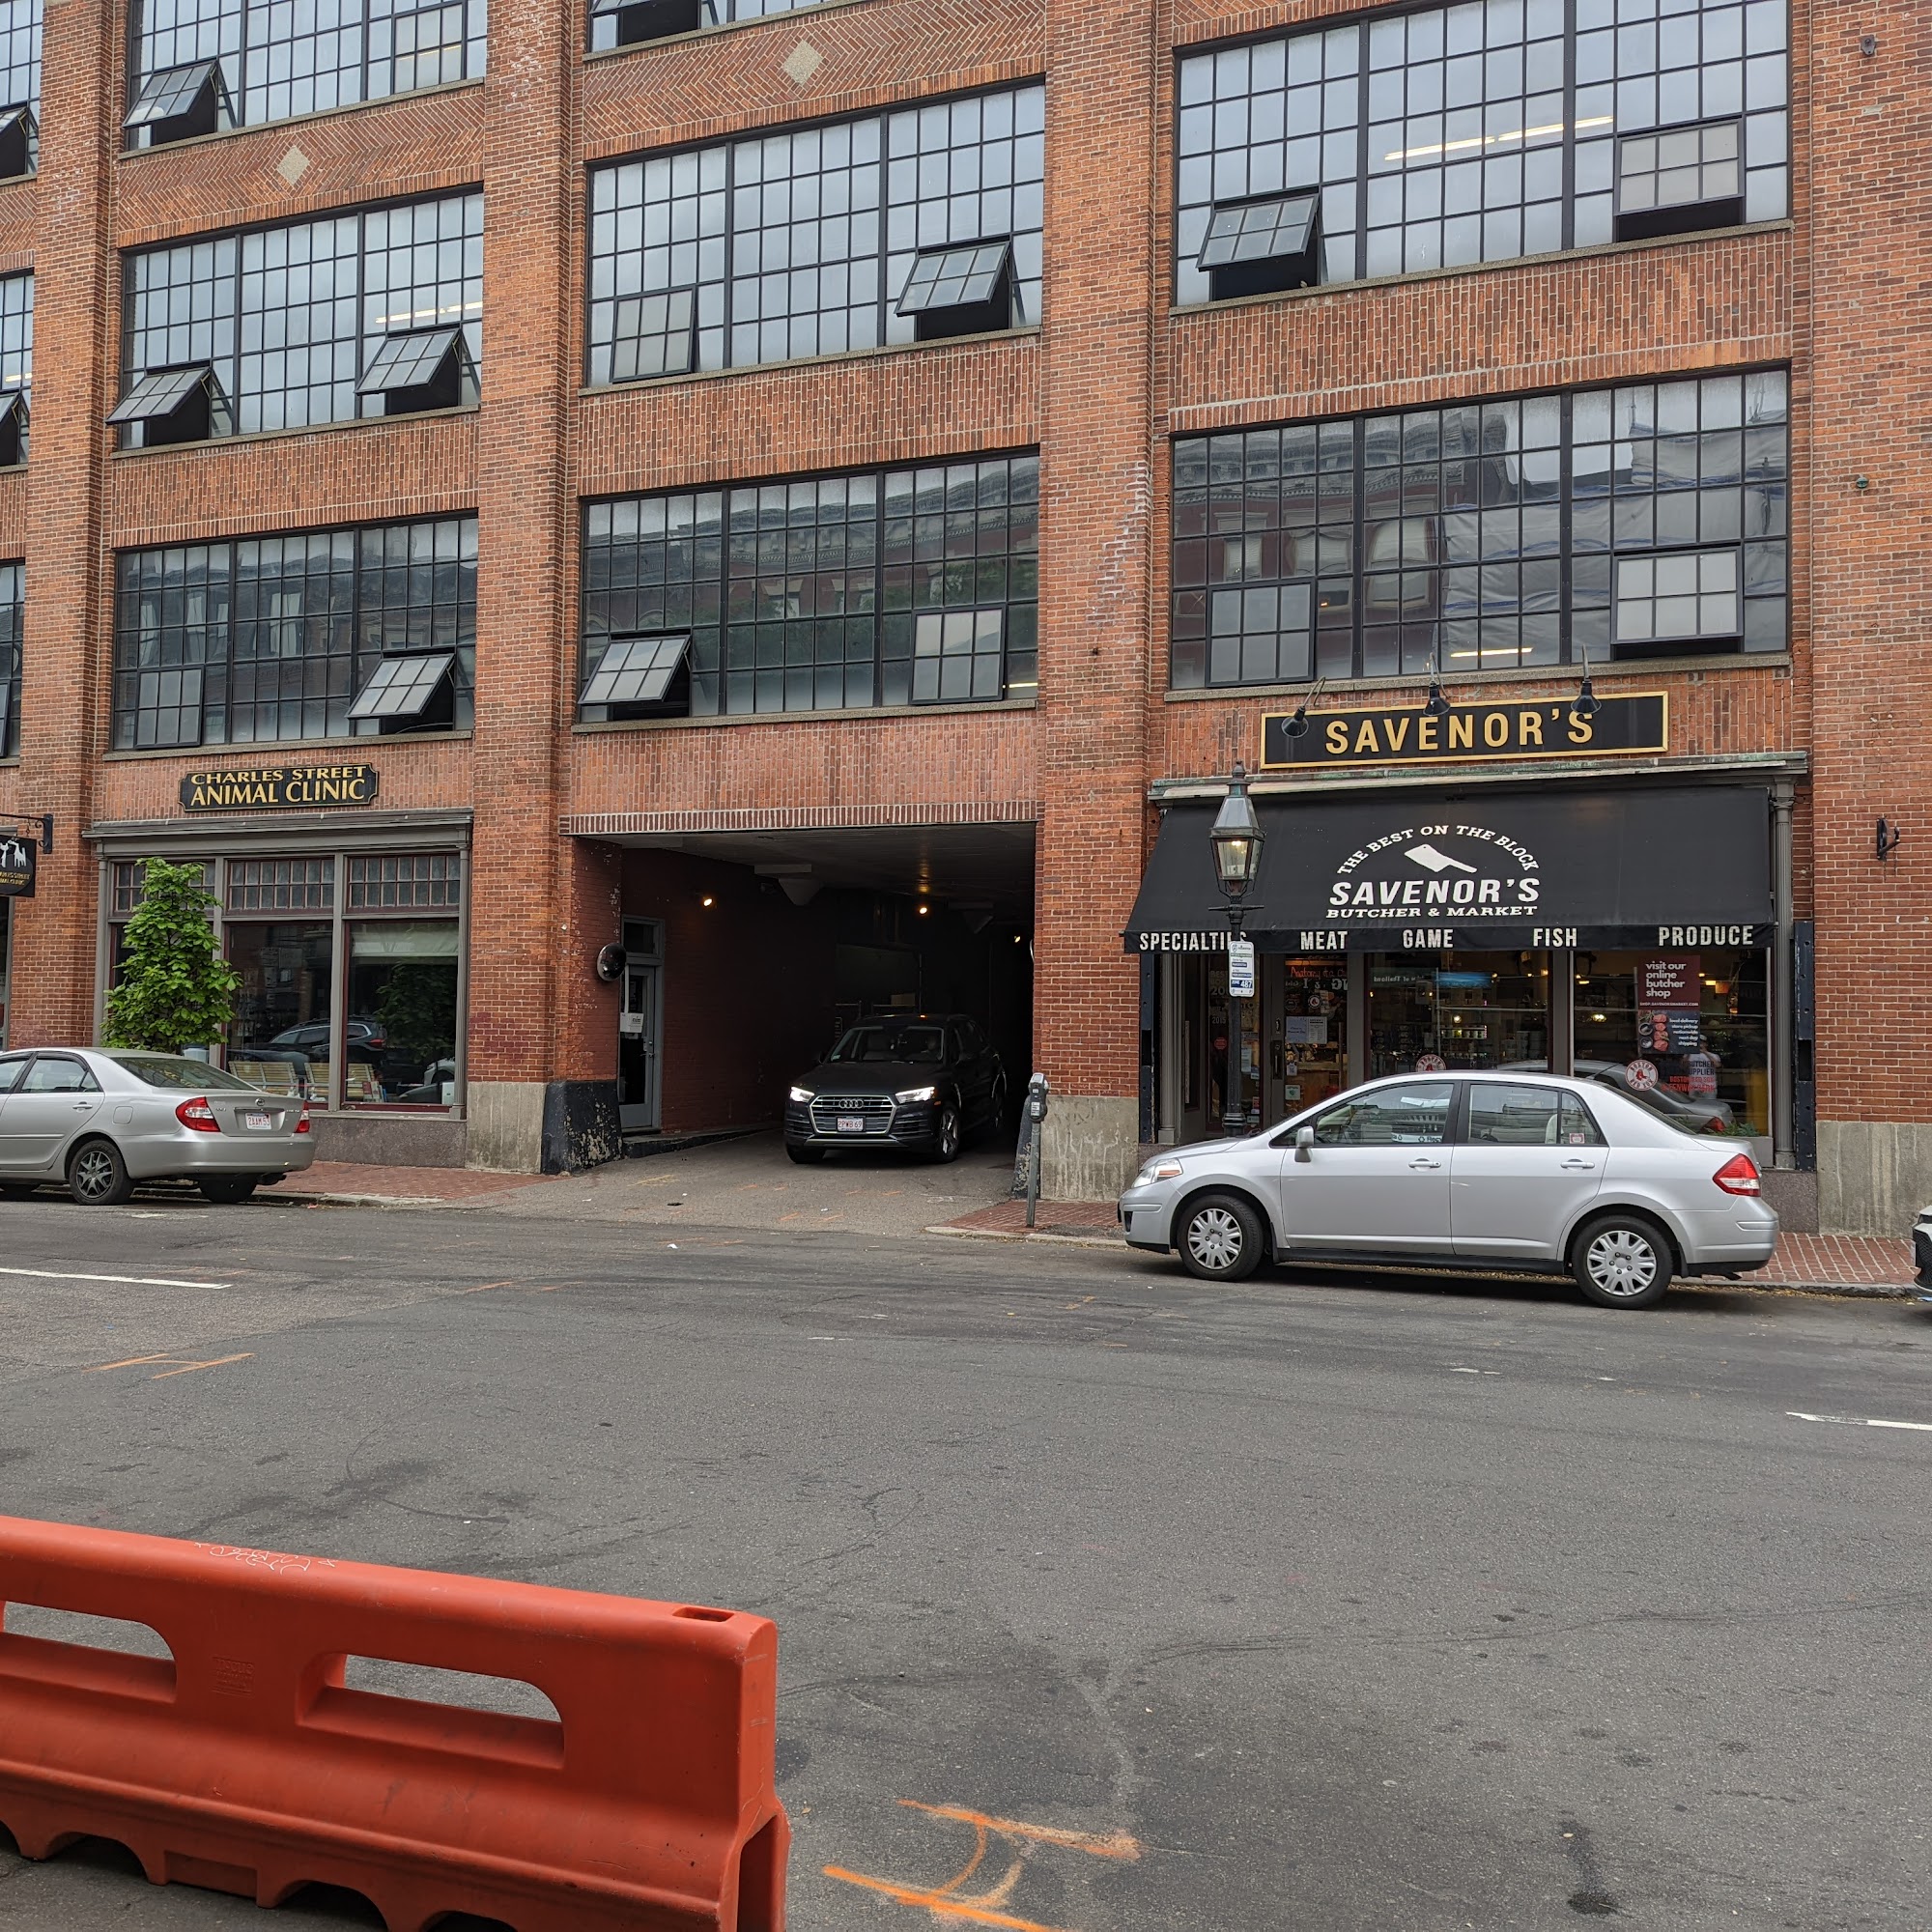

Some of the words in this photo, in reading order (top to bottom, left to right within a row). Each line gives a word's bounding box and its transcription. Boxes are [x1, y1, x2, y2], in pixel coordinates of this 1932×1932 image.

[1324, 707, 1594, 755] SAVENOR'S
[190, 769, 284, 785] CHARLES
[292, 765, 367, 781] STREET
[190, 782, 279, 807] ANIMAL
[285, 779, 365, 803] CLINIC
[1336, 849, 1370, 875] THE
[1365, 828, 1414, 853] BEST
[1420, 825, 1449, 836] ON
[1456, 825, 1496, 841] THE
[1493, 836, 1540, 871] BLOCK
[1328, 877, 1541, 906] SAVENOR'S
[1325, 907, 1422, 919] BUTCHER
[1427, 907, 1440, 917] &
[1446, 905, 1538, 917] MARKET
[1300, 930, 1348, 951] MEAT
[1403, 928, 1454, 949] GAME
[1532, 927, 1577, 948] FISH
[1658, 924, 1754, 947] PRODUCE
[1645, 961, 1666, 970] visit
[1646, 970, 1677, 979] online
[1646, 979, 1686, 988] butcher
[1646, 987, 1671, 999] shop
